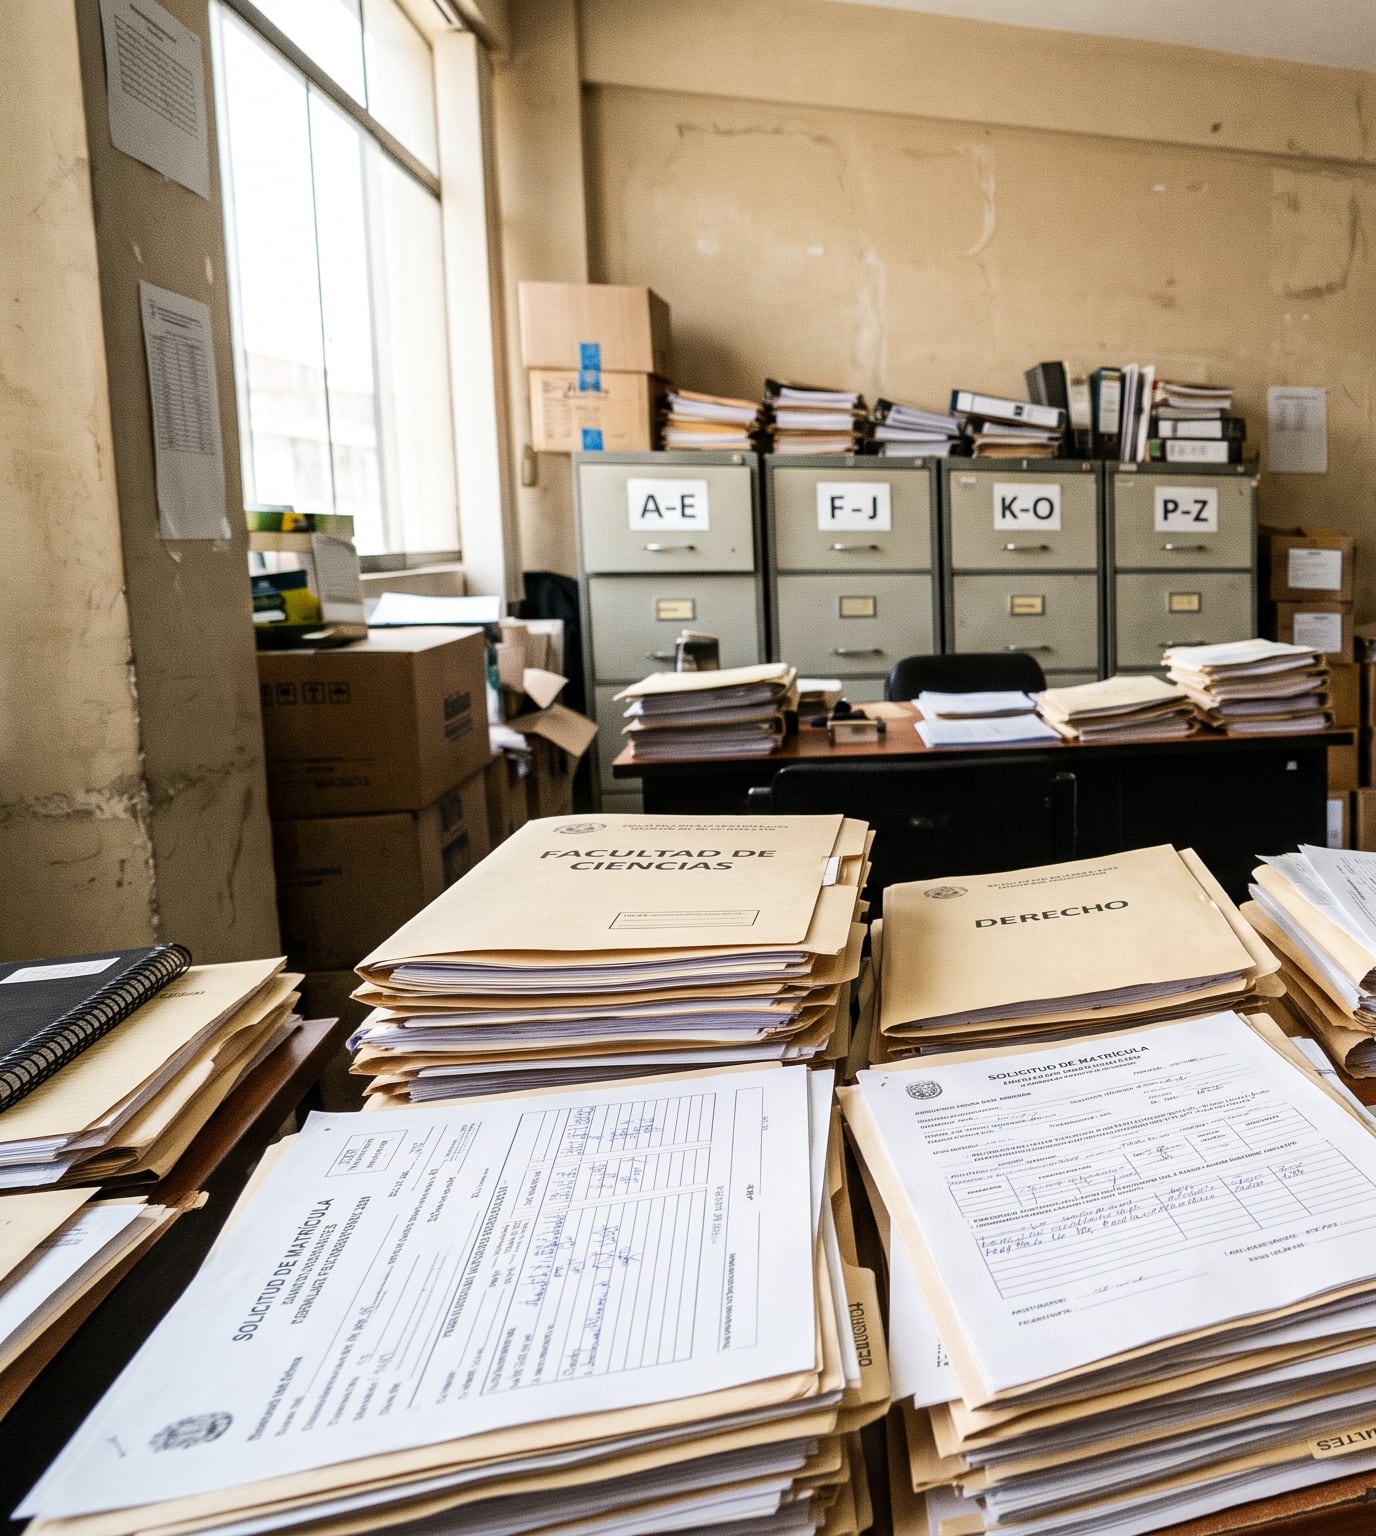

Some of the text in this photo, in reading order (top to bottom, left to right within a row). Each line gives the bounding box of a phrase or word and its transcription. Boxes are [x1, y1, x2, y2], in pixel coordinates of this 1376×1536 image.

[640, 492, 697, 520] A-E
[1000, 495, 1055, 521] K-O
[1162, 499, 1208, 523] P-Z
[540, 849, 777, 859] FACULTAD DE
[570, 861, 733, 871] CIENCIAS
[975, 900, 1129, 929] DERECHO
[988, 1064, 1057, 1081] SOLICITUD
[1058, 1060, 1078, 1068] DE
[284, 1198, 335, 1259] MATRÍCULA
[273, 1258, 297, 1277] DE
[232, 1278, 286, 1342] SOLICITUD
